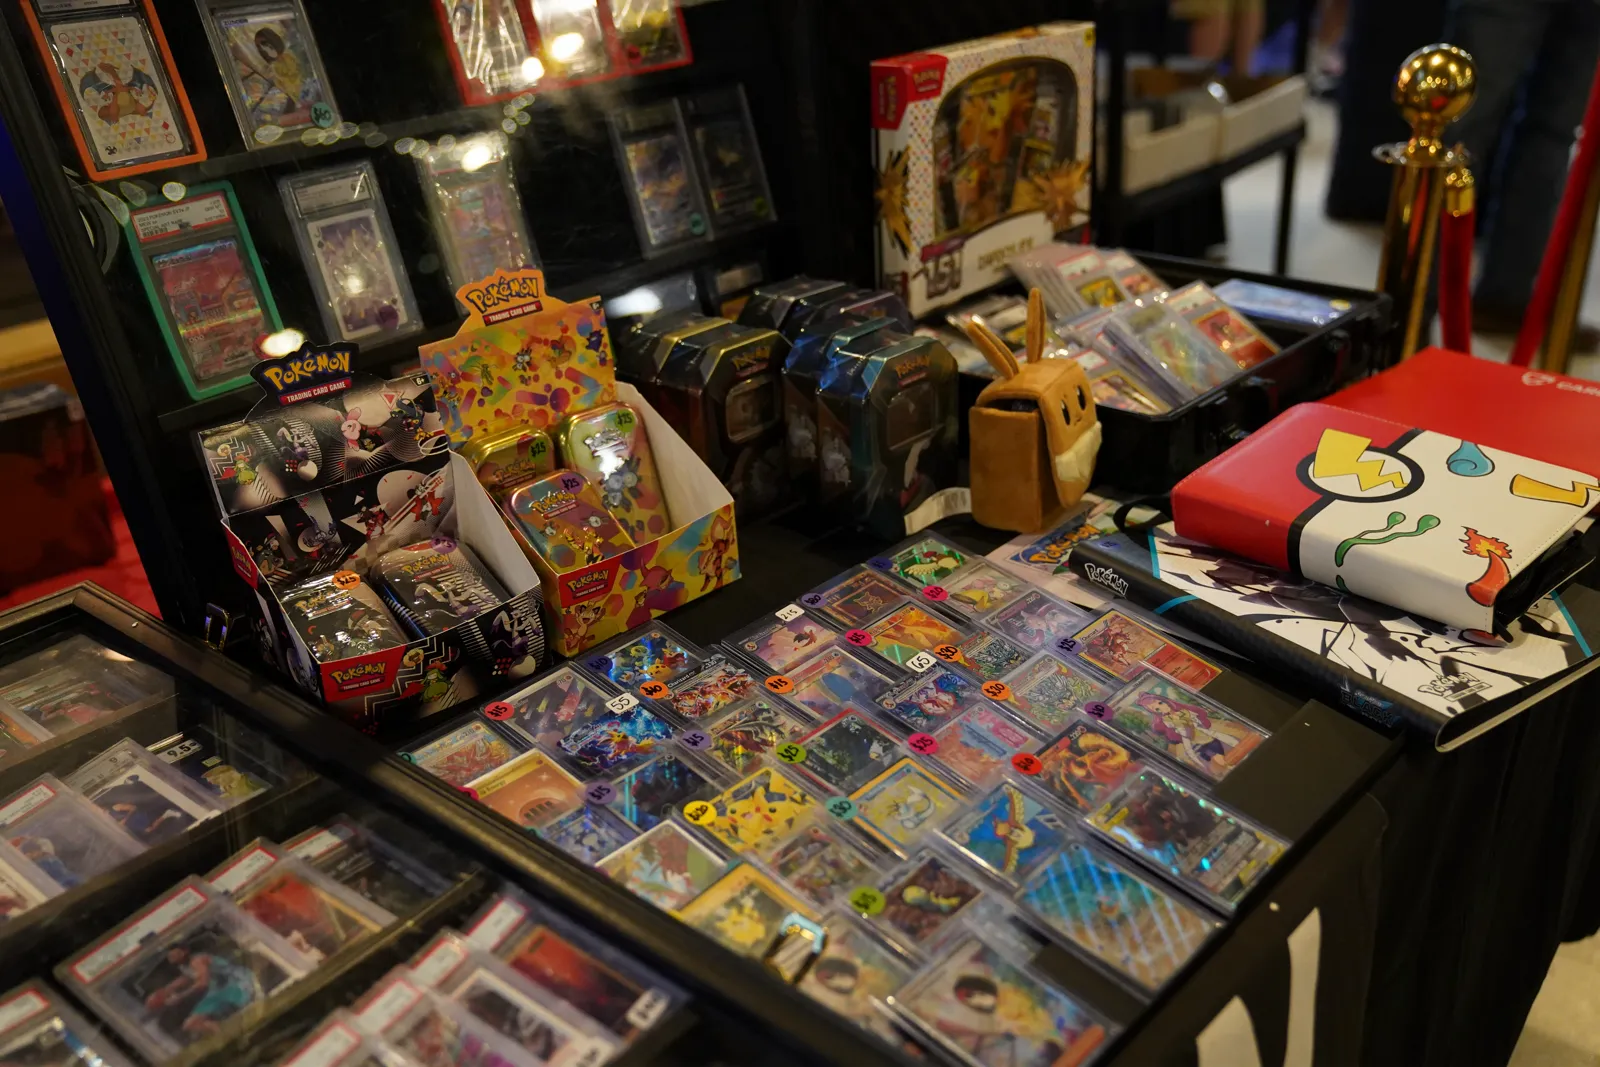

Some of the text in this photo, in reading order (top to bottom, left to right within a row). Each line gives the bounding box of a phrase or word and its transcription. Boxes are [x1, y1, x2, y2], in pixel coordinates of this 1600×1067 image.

[510, 308, 523, 317] CARD
[416, 377, 425, 385] 6+
[287, 381, 347, 403] TRADING CARD GAME
[530, 441, 547, 458] $25
[561, 477, 580, 492] $25
[928, 586, 944, 599] $20
[781, 608, 797, 620] 215
[1057, 638, 1077, 652] $25
[939, 646, 958, 661] $30
[913, 656, 930, 669] 65
[666, 673, 689, 689] Charizard
[767, 677, 788, 690] $15
[985, 683, 1006, 698] $30
[610, 696, 631, 711] 55
[490, 704, 508, 720] $15
[167, 743, 190, 758] 9.5
[912, 736, 934, 751] $25
[777, 744, 799, 762] $25
[588, 785, 611, 800] $15
